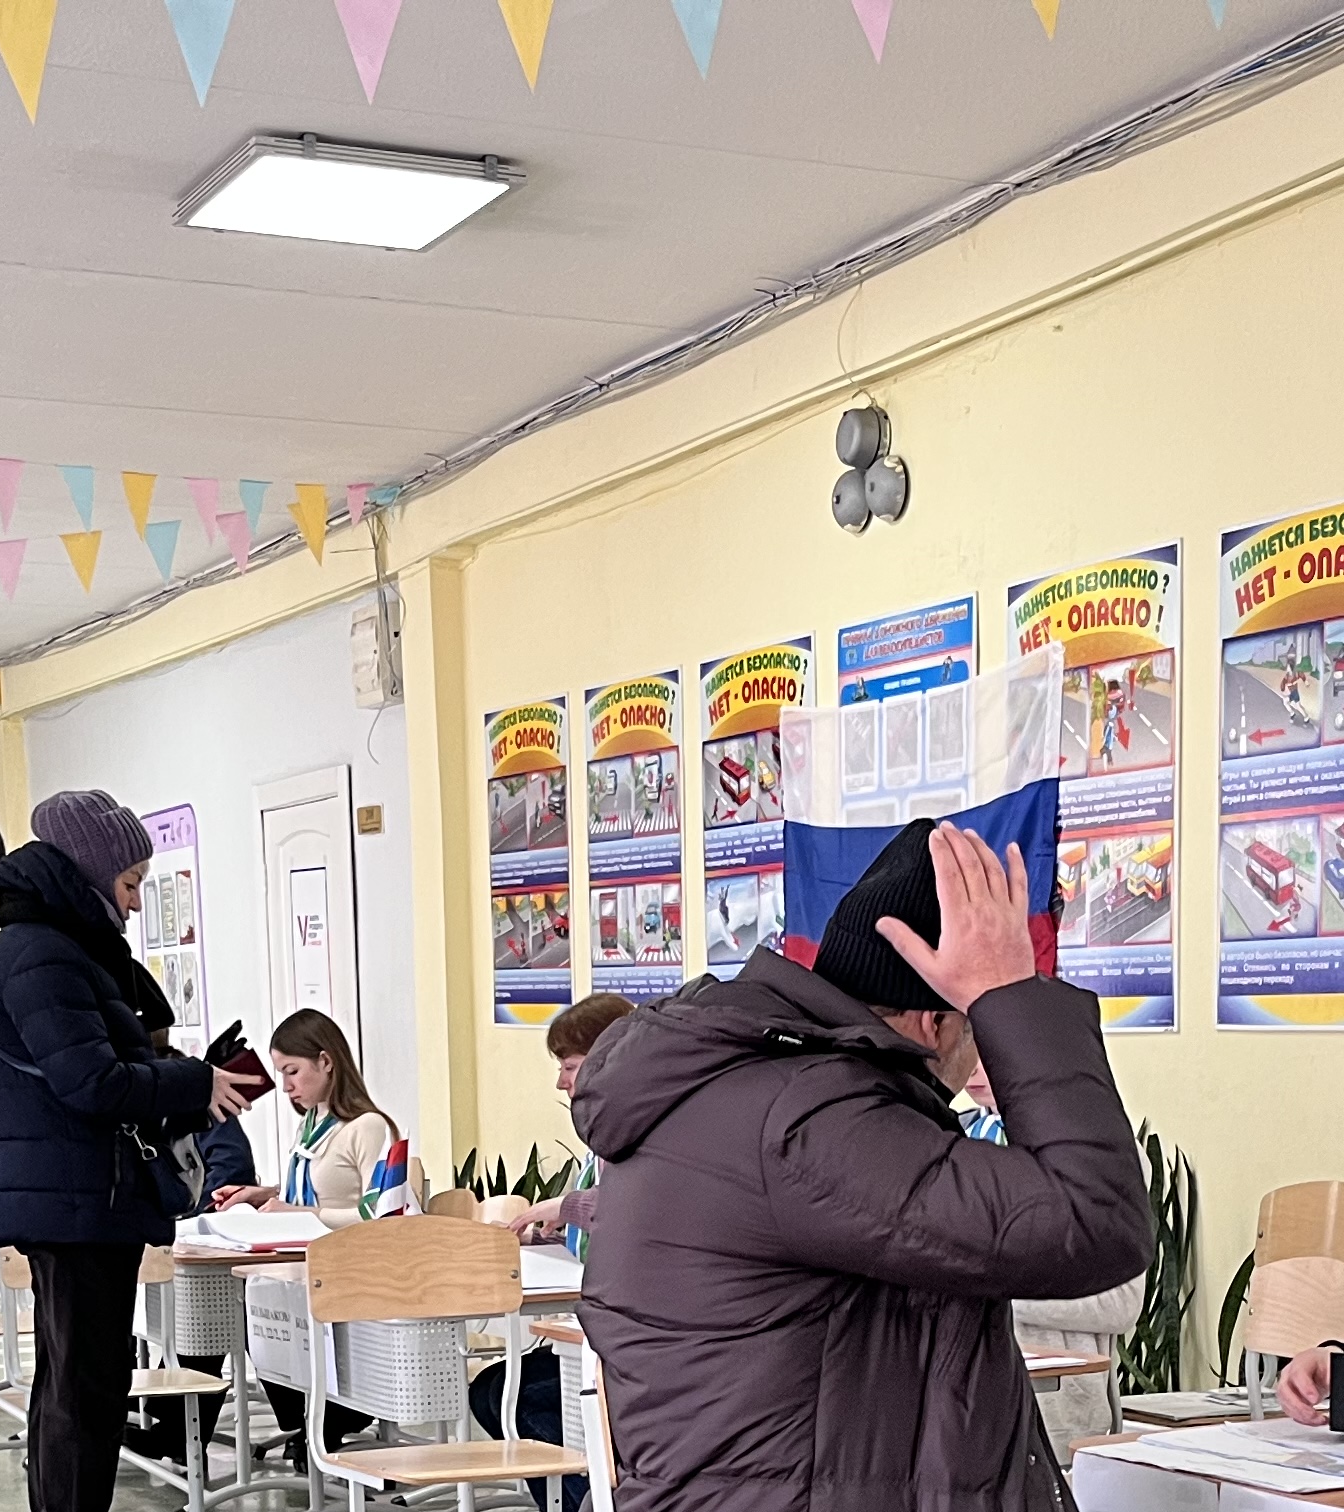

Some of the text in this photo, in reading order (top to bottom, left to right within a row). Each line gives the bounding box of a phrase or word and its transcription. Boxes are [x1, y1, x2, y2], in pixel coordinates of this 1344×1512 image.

[1229, 524, 1305, 581] КАЖЕТСЯ
[1014, 578, 1072, 629] КАЖЕТСЯ
[1076, 568, 1158, 595] БЕЗОПАСНО
[1235, 565, 1276, 618] НЕТ
[1019, 615, 1052, 656] НЕТ
[1067, 597, 1151, 632] ОПАСНО
[705, 658, 745, 699] КАЖЕТСЯ
[747, 652, 801, 673] БЕЗОПАСНО
[708, 689, 730, 726] НЕТ
[741, 676, 797, 703] ОПАСНО
[491, 735, 507, 766] НЕТ
[515, 727, 555, 750] ОПАСНО
[592, 714, 611, 747] НЕТ
[620, 704, 666, 729] ОПАСНО
